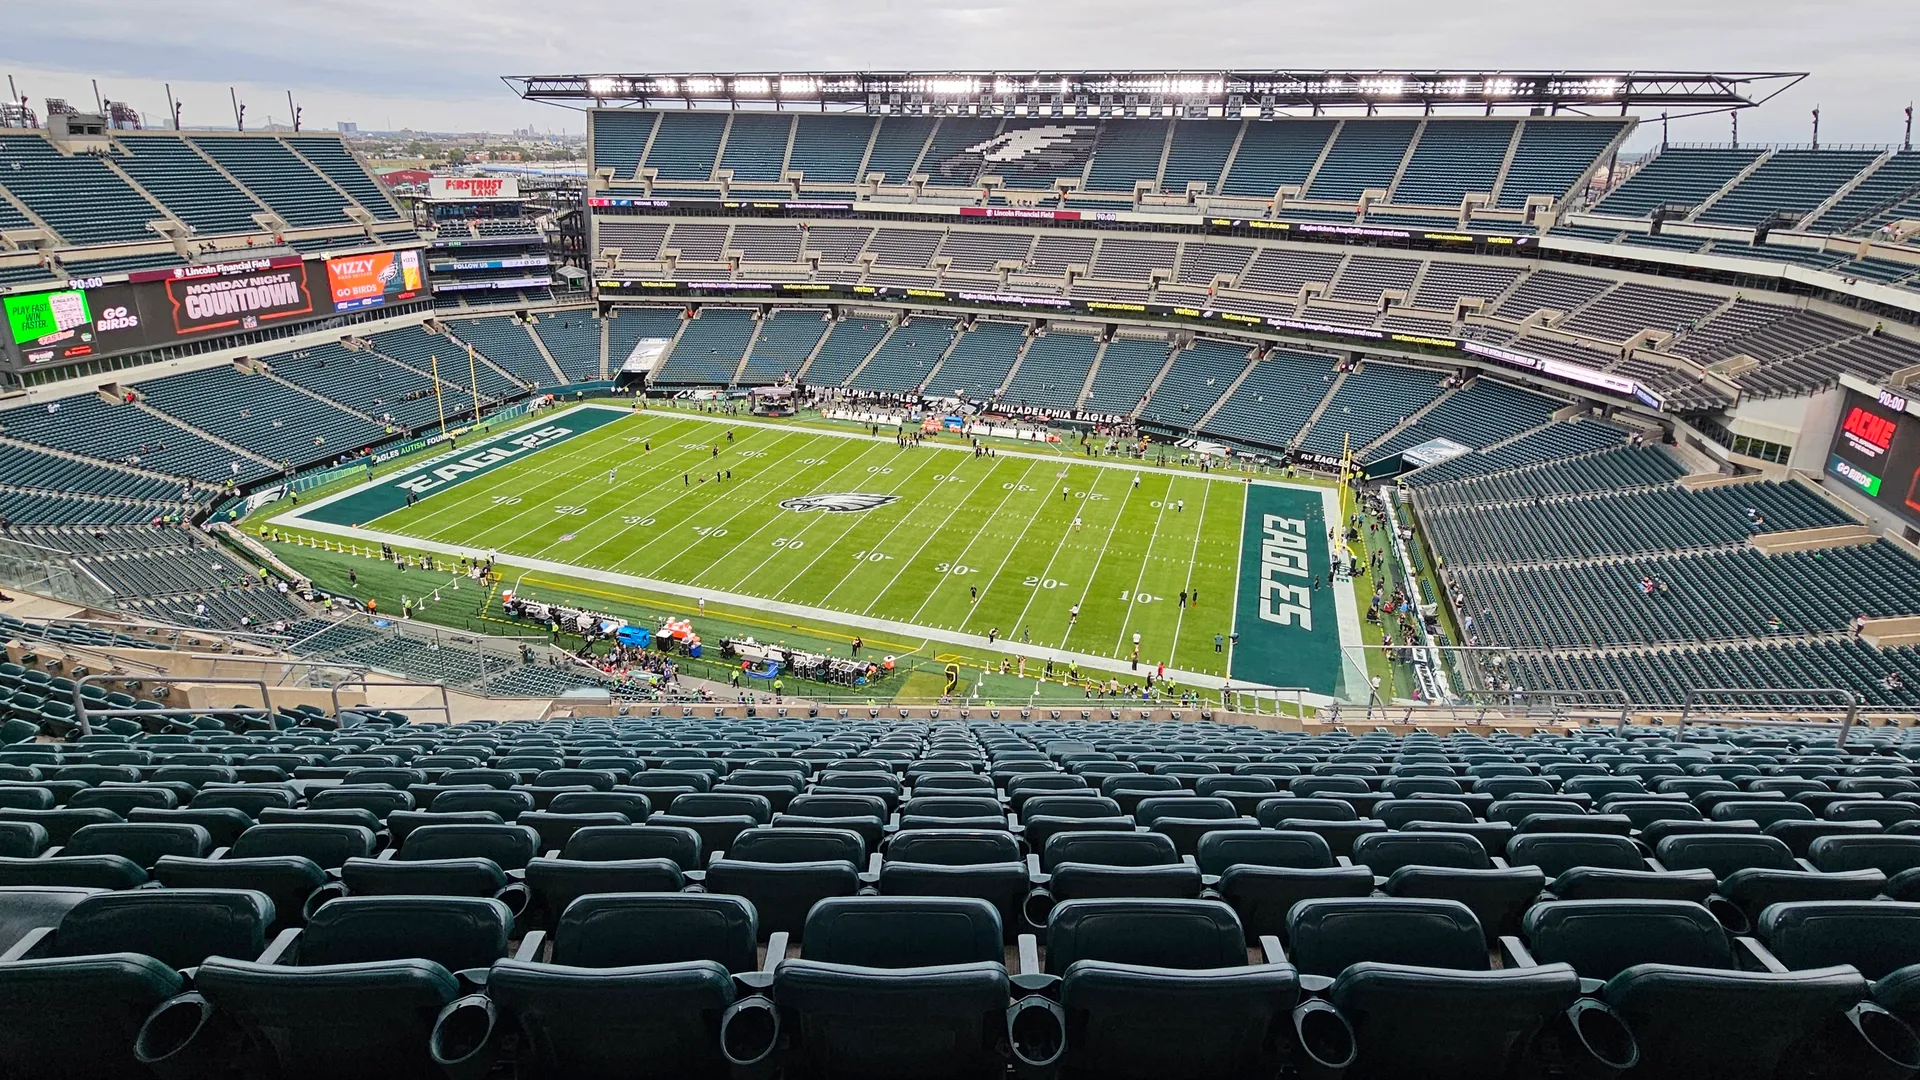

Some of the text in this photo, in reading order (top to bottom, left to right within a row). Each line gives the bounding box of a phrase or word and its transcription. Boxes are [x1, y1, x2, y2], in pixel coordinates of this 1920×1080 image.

[1212, 218, 1230, 226] verizon
[1249, 221, 1269, 229] Verizon
[1336, 228, 1363, 236] hospitality
[1424, 233, 1473, 242] verizon.com/access
[1487, 236, 1513, 244] verizon
[185, 265, 216, 277] Lincoln
[217, 261, 252, 273] Financial
[252, 259, 270, 269] Field
[331, 259, 375, 275] VIZZY
[453, 262, 478, 270] FOLLOW
[69, 277, 103, 290] 90:00
[186, 273, 290, 296] MONDAY NIGHT
[853, 286, 875, 294] verizon
[336, 284, 377, 297] GO BIRDS
[907, 288, 945, 298] Verizon Access
[185, 281, 300, 320] COUNTDOWN
[959, 292, 976, 301] Eagles
[977, 294, 996, 302] tickets,
[997, 296, 1024, 304] hospitality
[12, 303, 49, 316] PLAY FAST.
[103, 306, 128, 319] GO
[1087, 302, 1145, 311] verizon.com/access
[1174, 307, 1199, 316] verizon
[25, 312, 41, 321] WIN
[1222, 312, 1261, 323] Verizon Access
[22, 319, 49, 331] FASTER.
[97, 315, 138, 332] BIRDS
[1267, 318, 1285, 327] Eagles
[1286, 320, 1304, 329] tickets,
[1305, 322, 1334, 333] hospitality
[1392, 334, 1456, 348] verizon.com/access
[1878, 391, 1905, 412] 90:00
[991, 403, 1121, 424] PHILADELPHIA EAGLES
[1843, 407, 1897, 450] ACME
[373, 449, 399, 464] AGLES
[401, 440, 426, 455] AUTISM
[394, 425, 573, 493] EAGLES
[1300, 453, 1361, 472] FLY EAGLES FLY
[1836, 462, 1872, 488] GO BIRDS
[555, 505, 588, 515] 20
[624, 515, 656, 526] 30
[696, 526, 728, 538] 40
[771, 537, 804, 550] 50
[852, 550, 884, 562] 40
[934, 562, 969, 575] 30
[1259, 513, 1312, 632] EAGLES
[1022, 576, 1057, 589] 20
[1118, 590, 1152, 604] 10
